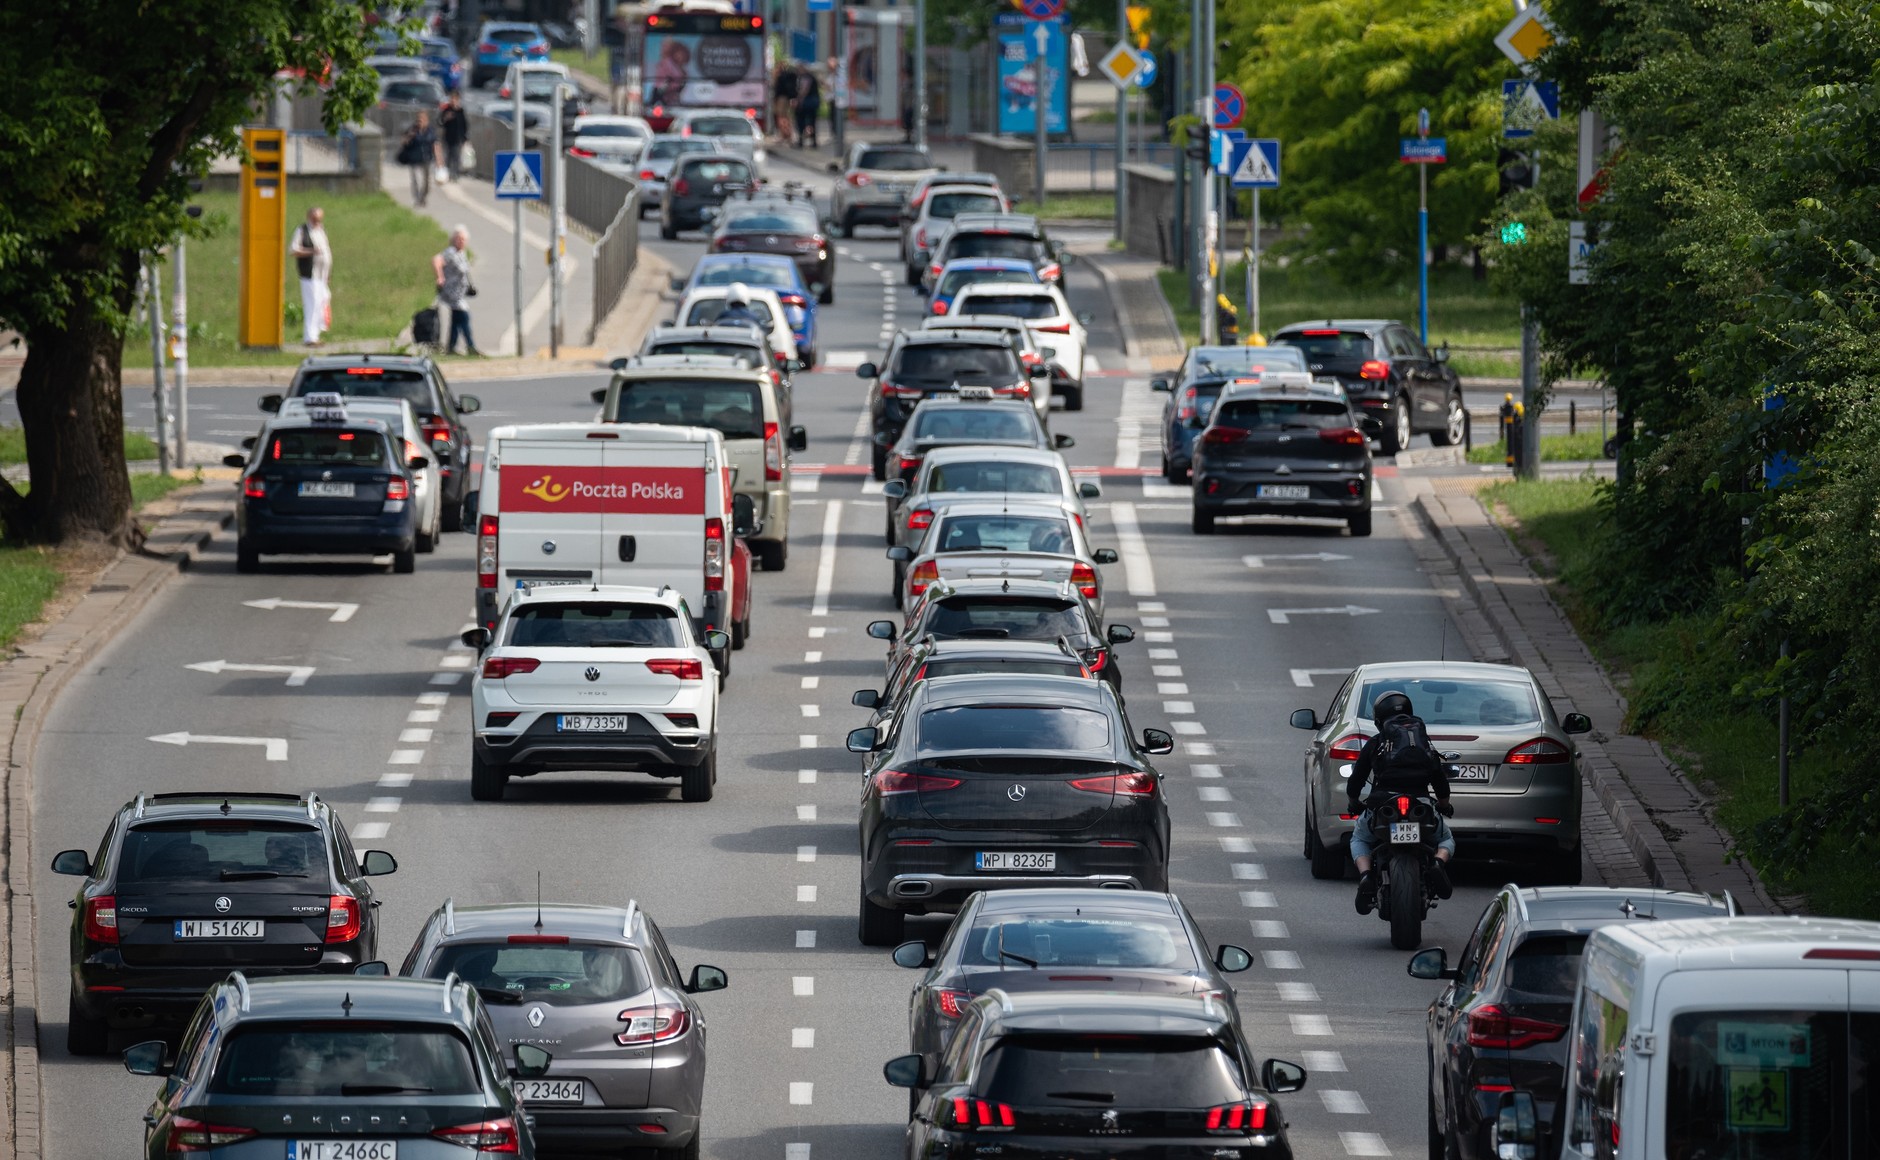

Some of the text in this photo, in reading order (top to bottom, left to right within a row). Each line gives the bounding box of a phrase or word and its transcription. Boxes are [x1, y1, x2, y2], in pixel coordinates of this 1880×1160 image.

[573, 481, 684, 499] Poczta Polska
[565, 716, 625, 729] WB 7335W
[1457, 766, 1486, 779] 2SN
[1400, 824, 1412, 832] WN
[1393, 833, 1418, 841] 4659
[983, 853, 1054, 868] WPI 8236F
[185, 921, 203, 937] WI
[211, 921, 259, 937] 516KJ
[1751, 1038, 1784, 1049] MTON
[531, 1082, 581, 1099] 23464
[300, 1143, 325, 1160] WT
[332, 1143, 392, 1160] 2466C
